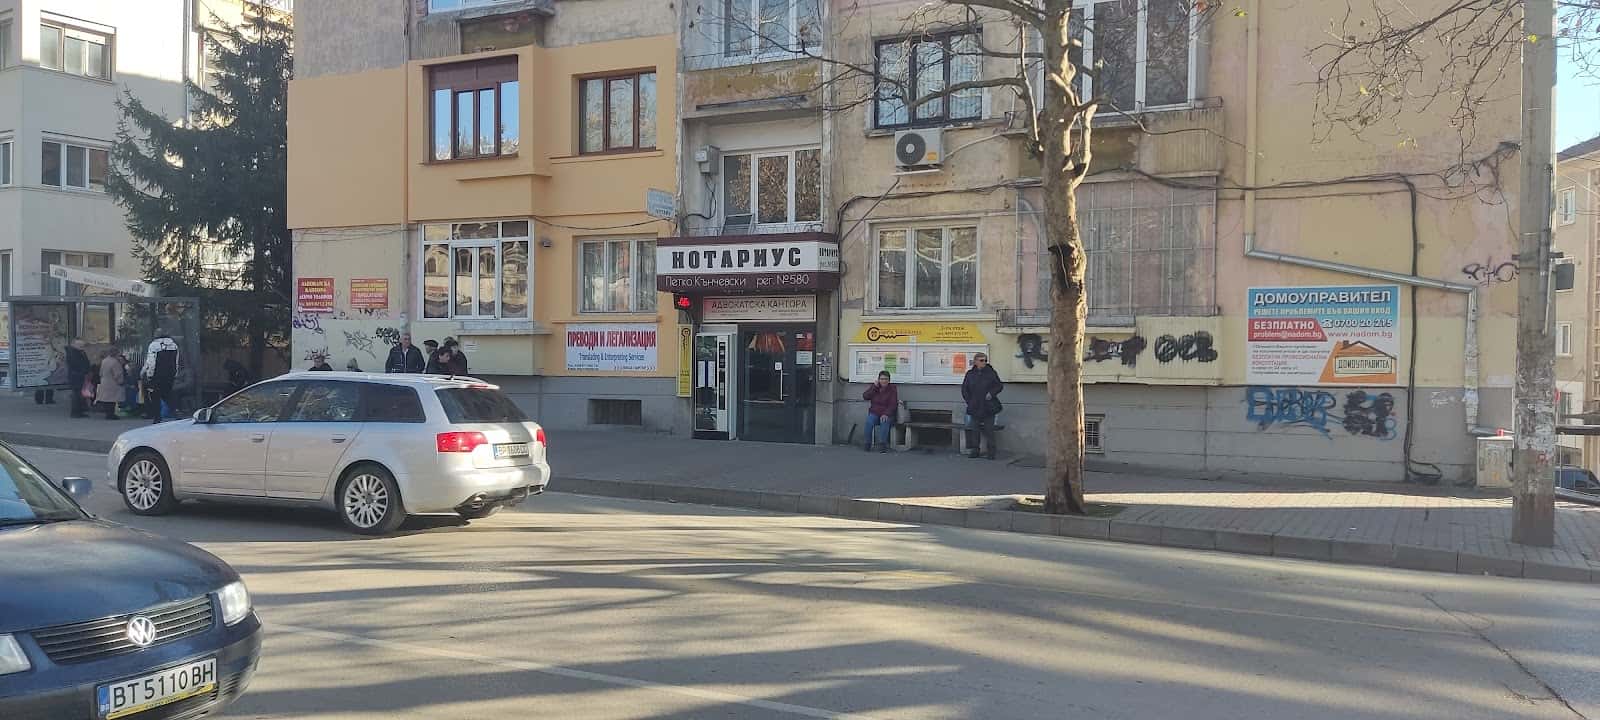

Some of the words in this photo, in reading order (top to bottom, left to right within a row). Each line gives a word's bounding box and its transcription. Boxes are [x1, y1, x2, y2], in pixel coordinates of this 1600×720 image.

[671, 247, 801, 269] НОТАРИУС
[665, 275, 693, 287] Петко
[694, 274, 746, 287] Кънчевски
[756, 274, 775, 289] рег.
[776, 272, 810, 285] №580
[1254, 290, 1391, 305] ДОМОУПРАВИТЕЛ
[711, 299, 765, 309] АДВОКАТСКА
[767, 298, 807, 309] КАНТОРА
[1253, 320, 1315, 330] БЕЗПЛАТНО
[1334, 319, 1358, 328] 0700
[1360, 319, 1372, 328] 20
[1374, 318, 1393, 328] 215
[1253, 331, 1322, 339] problem@nadom.bg
[1328, 330, 1393, 338] www.nadom.bg
[567, 330, 599, 350] ПРЕВОДИ
[600, 331, 605, 348] И
[606, 330, 657, 350] ЛЕГАЛИЗАЦИЯ
[628, 352, 645, 361] Services
[1338, 359, 1390, 369] ДОМОУПРАВИТЕЛ
[113, 682, 140, 708] BT
[144, 670, 188, 700] 5110
[192, 662, 213, 687] BH
